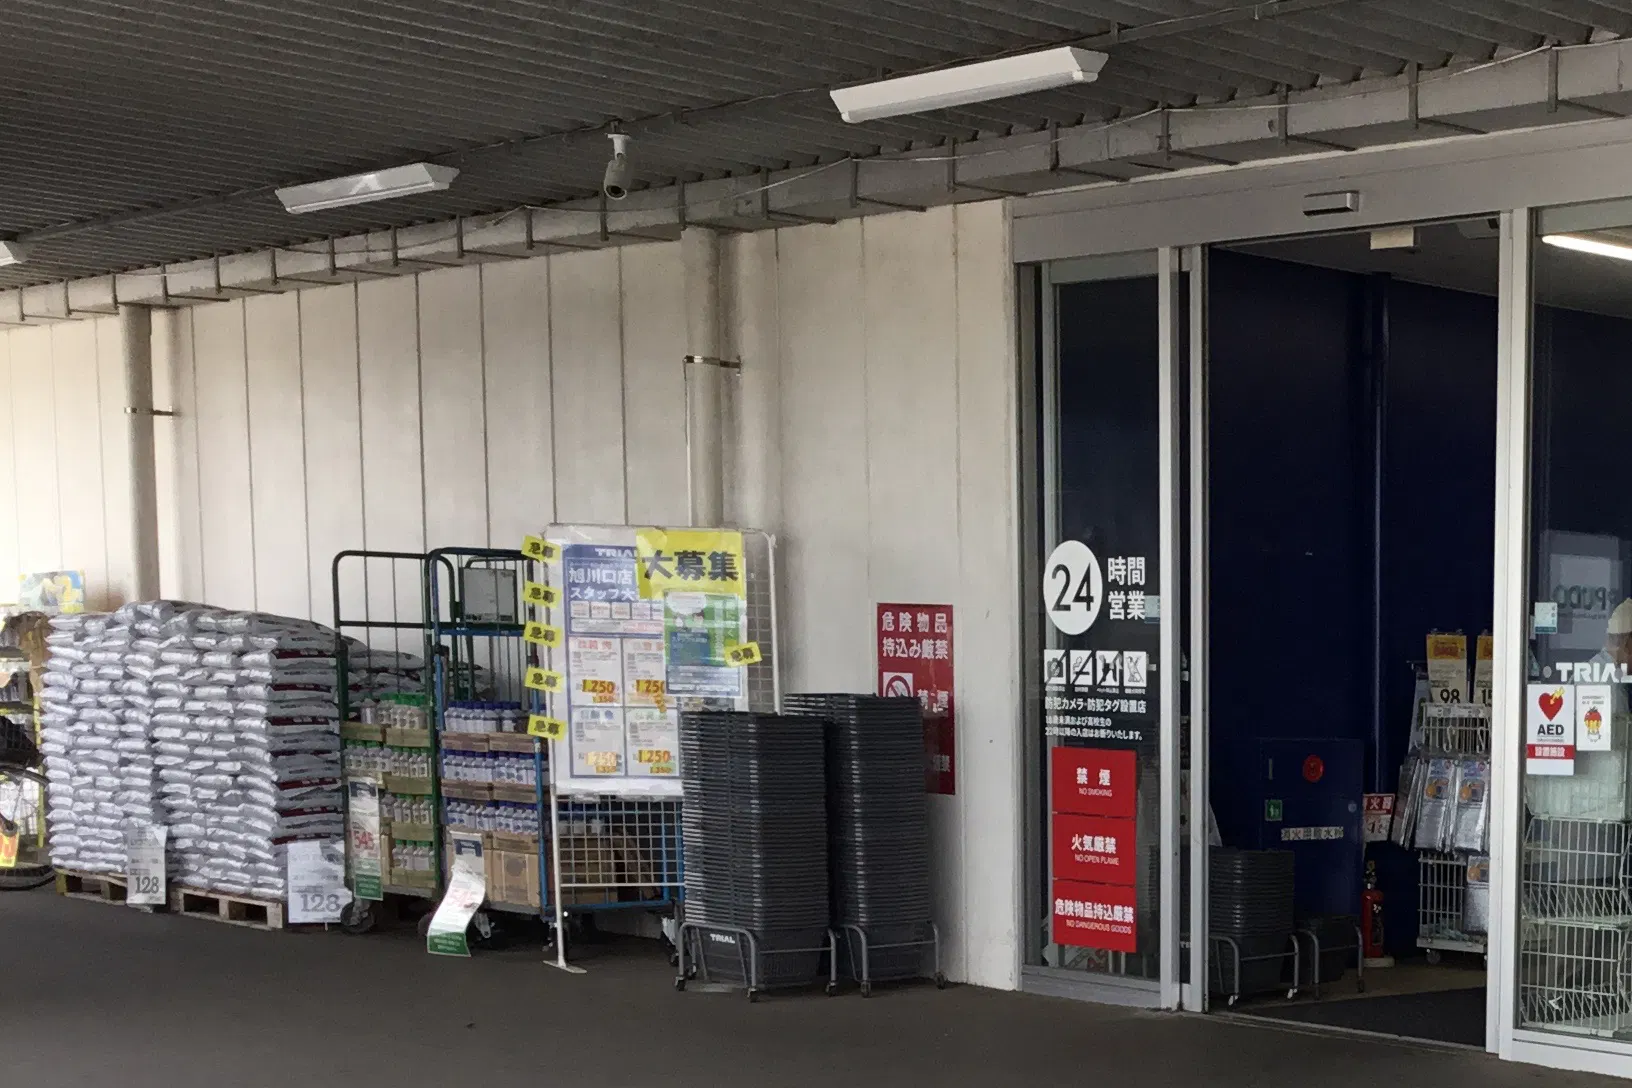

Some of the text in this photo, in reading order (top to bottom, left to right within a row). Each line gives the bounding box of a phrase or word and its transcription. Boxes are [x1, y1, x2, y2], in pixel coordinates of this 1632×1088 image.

[595, 547, 636, 557] TRIA
[569, 567, 633, 585] 旭川口店
[642, 549, 739, 582] 大募集
[1107, 555, 1146, 586] 時間
[1052, 562, 1094, 612] 24
[1107, 590, 1146, 620] 営業
[881, 611, 948, 634] 危険物品
[882, 637, 949, 660] 持込み厳禁
[1537, 724, 1565, 735] AED
[1076, 767, 1111, 786] 禁煙
[1071, 833, 1116, 854] 火気厳禁
[135, 876, 159, 895] 128
[300, 893, 340, 912] 128
[1055, 898, 1134, 924] 危険物品持込厳禁
[710, 933, 736, 944] TRIAL
